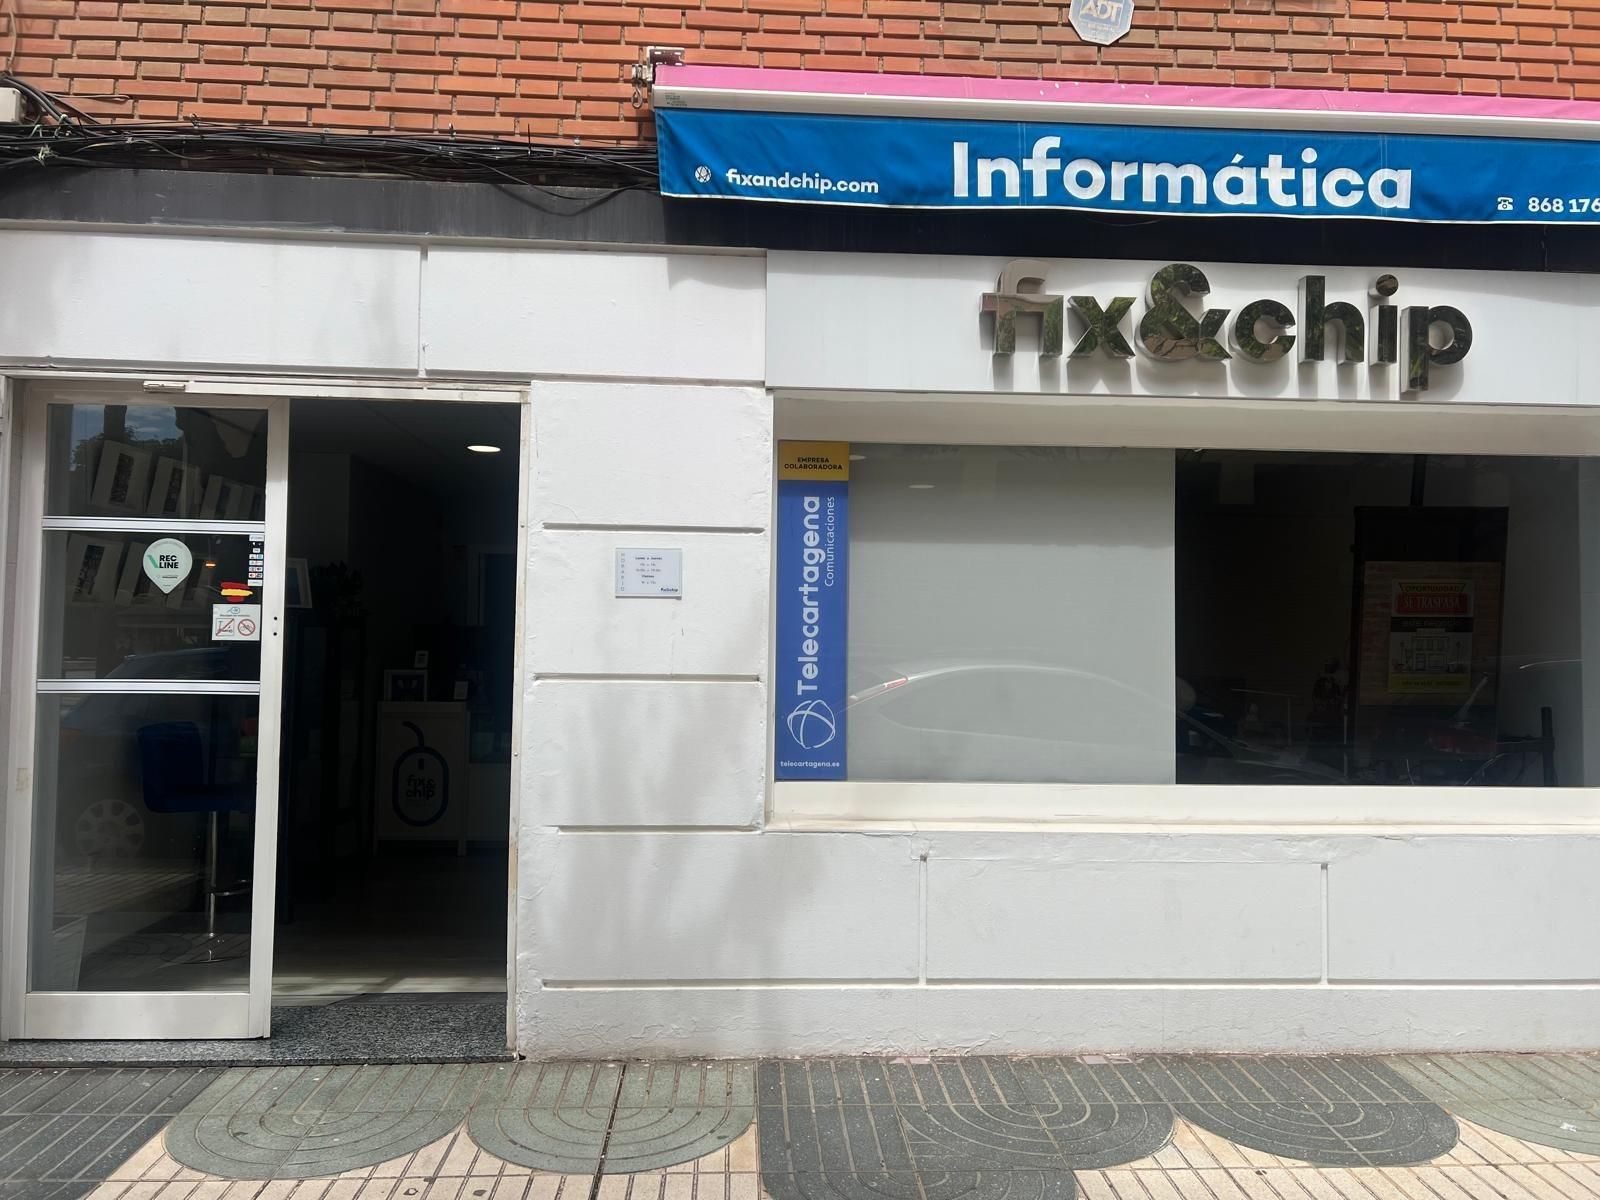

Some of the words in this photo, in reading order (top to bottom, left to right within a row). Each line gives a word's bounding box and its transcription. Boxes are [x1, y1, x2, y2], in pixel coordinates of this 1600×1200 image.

[1080, 0, 1123, 22] ADT
[725, 168, 879, 194] fixandchip.com
[952, 136, 1412, 209] Informática
[1528, 197, 1564, 213] 868
[1568, 198, 1600, 213] 176
[979, 259, 1474, 392] fix&chip
[797, 456, 830, 464] EMPRESA
[824, 496, 835, 587] Comunicaciones
[159, 554, 177, 562] REC
[797, 496, 826, 696] Telecartagena
[780, 760, 840, 769] telecartagena.es
